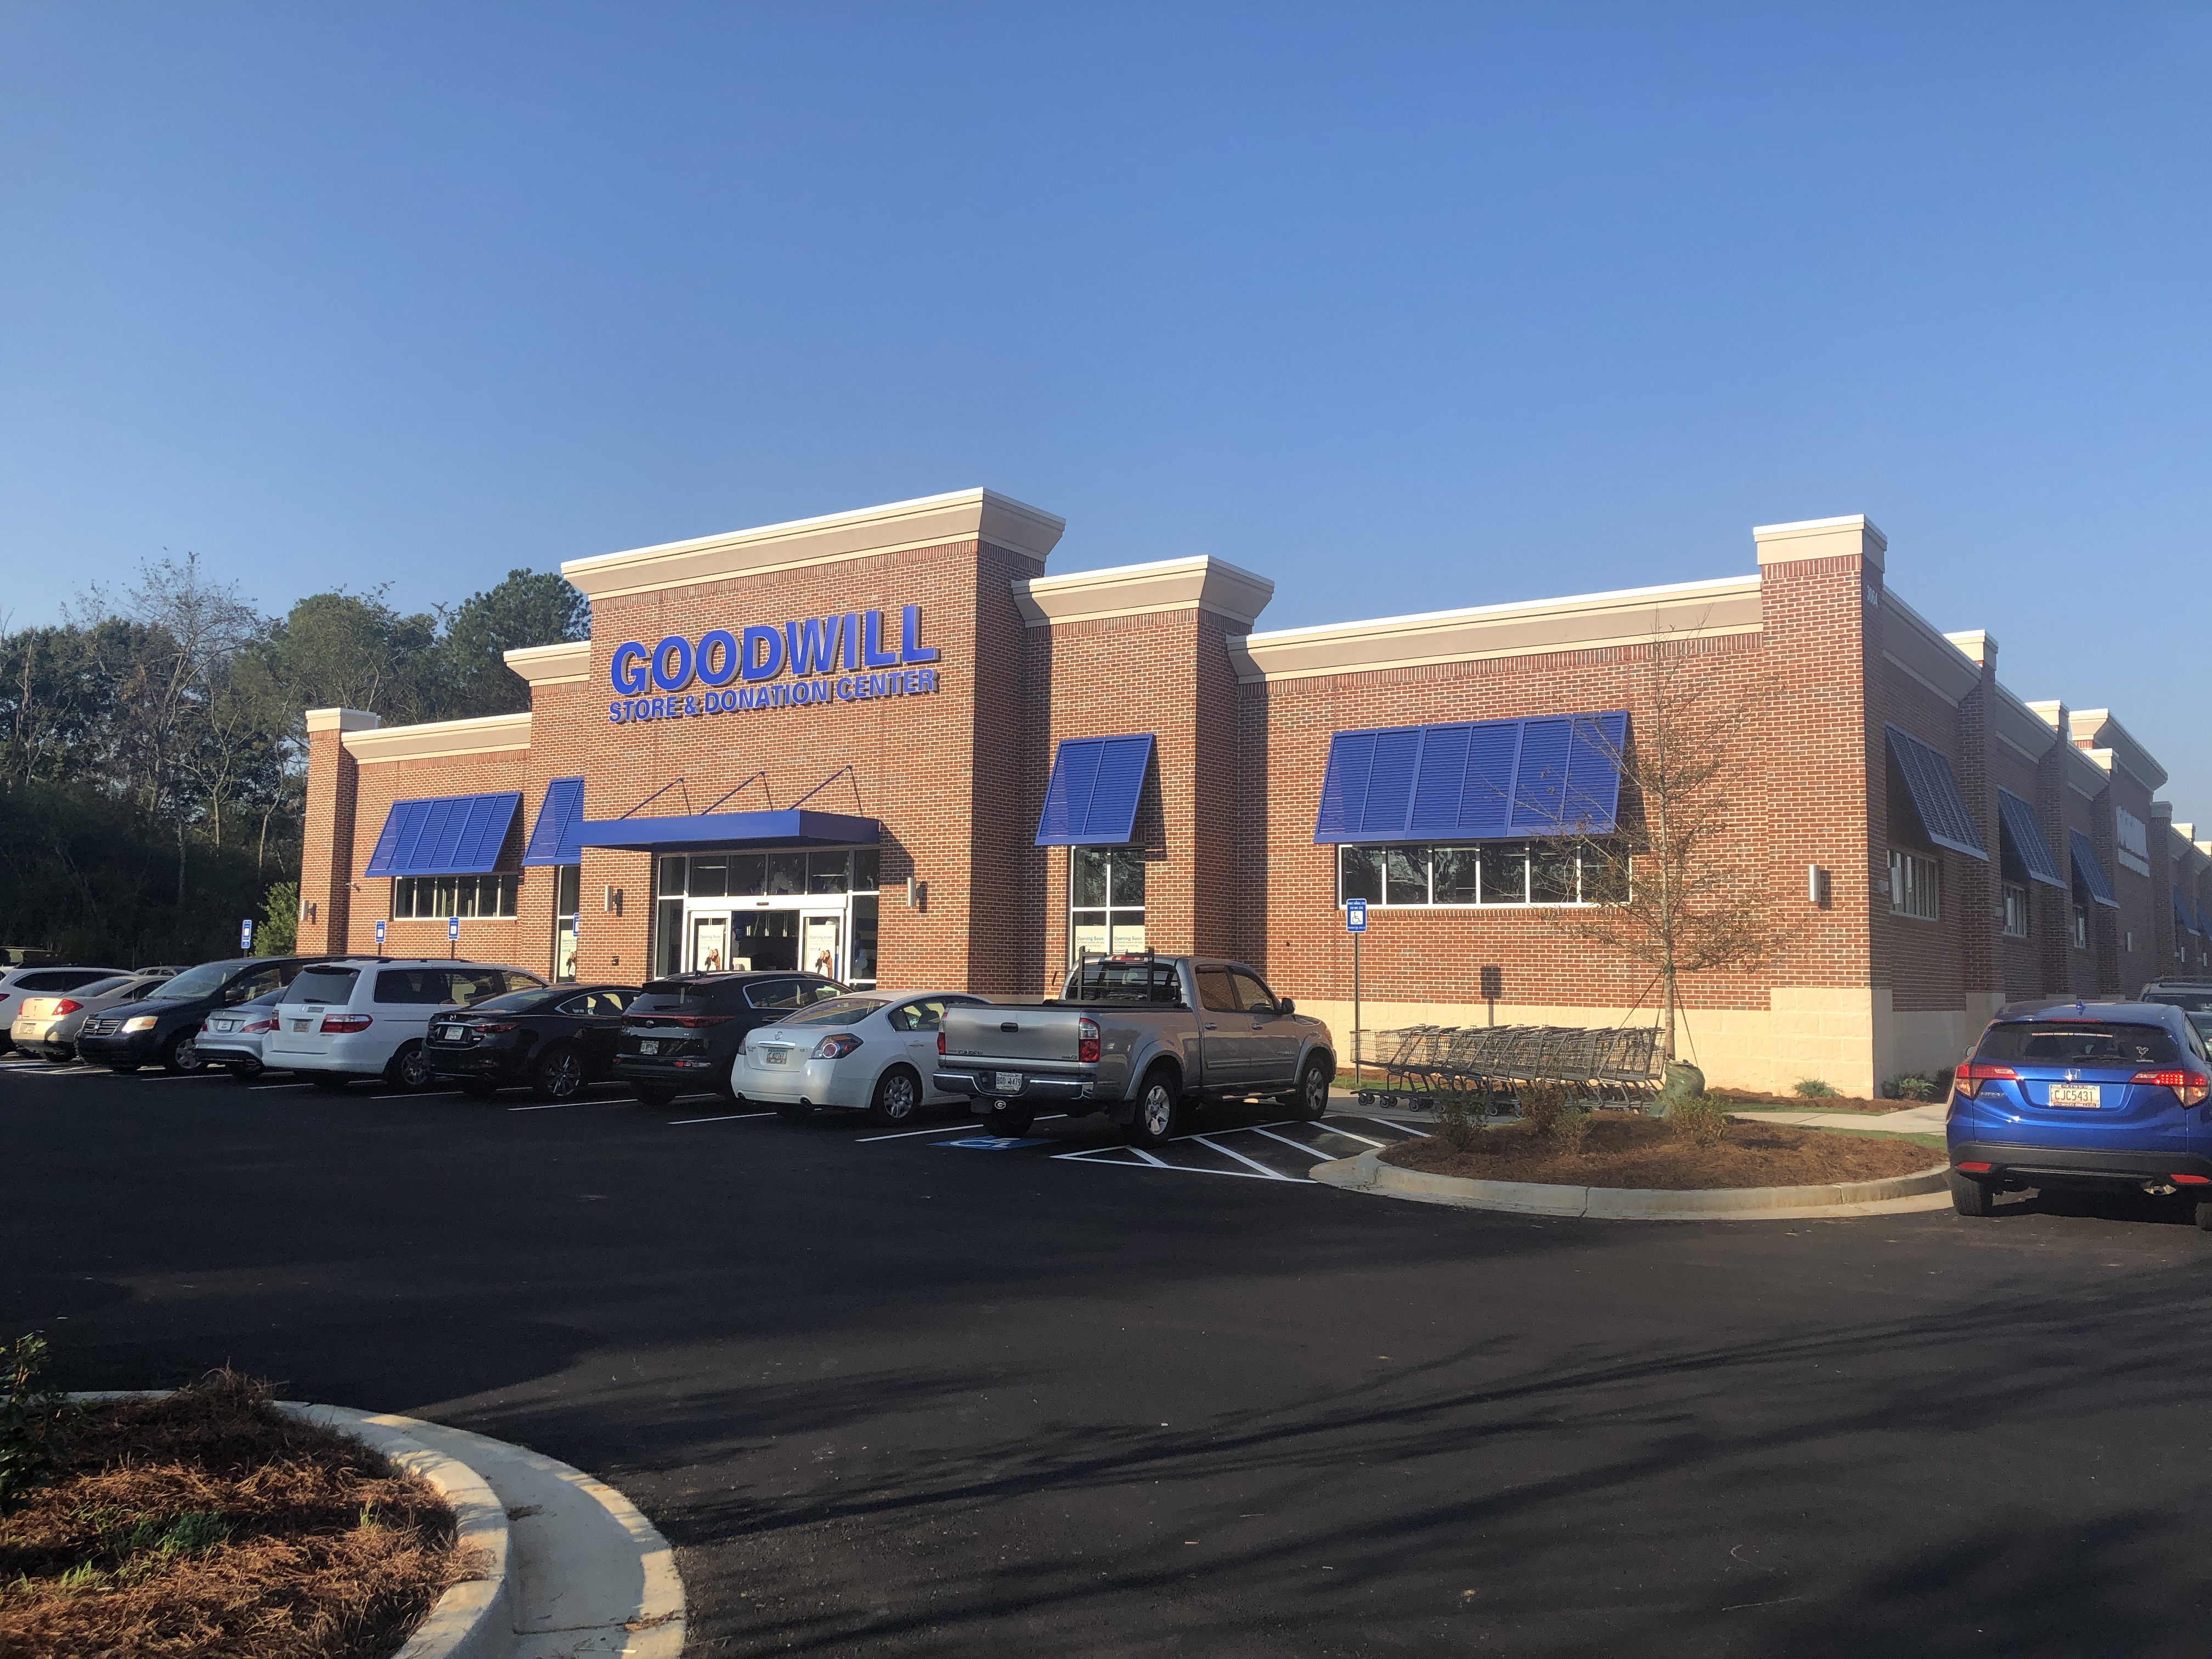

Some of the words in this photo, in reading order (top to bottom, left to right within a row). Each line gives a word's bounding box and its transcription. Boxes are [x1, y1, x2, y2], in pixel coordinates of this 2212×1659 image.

[610, 604, 936, 696] GOODWILL
[609, 697, 677, 723] STORE
[684, 695, 697, 713] &
[705, 679, 827, 713] DONATION
[836, 669, 935, 700] CENTER
[2055, 1090, 2093, 1102] CJC5431
